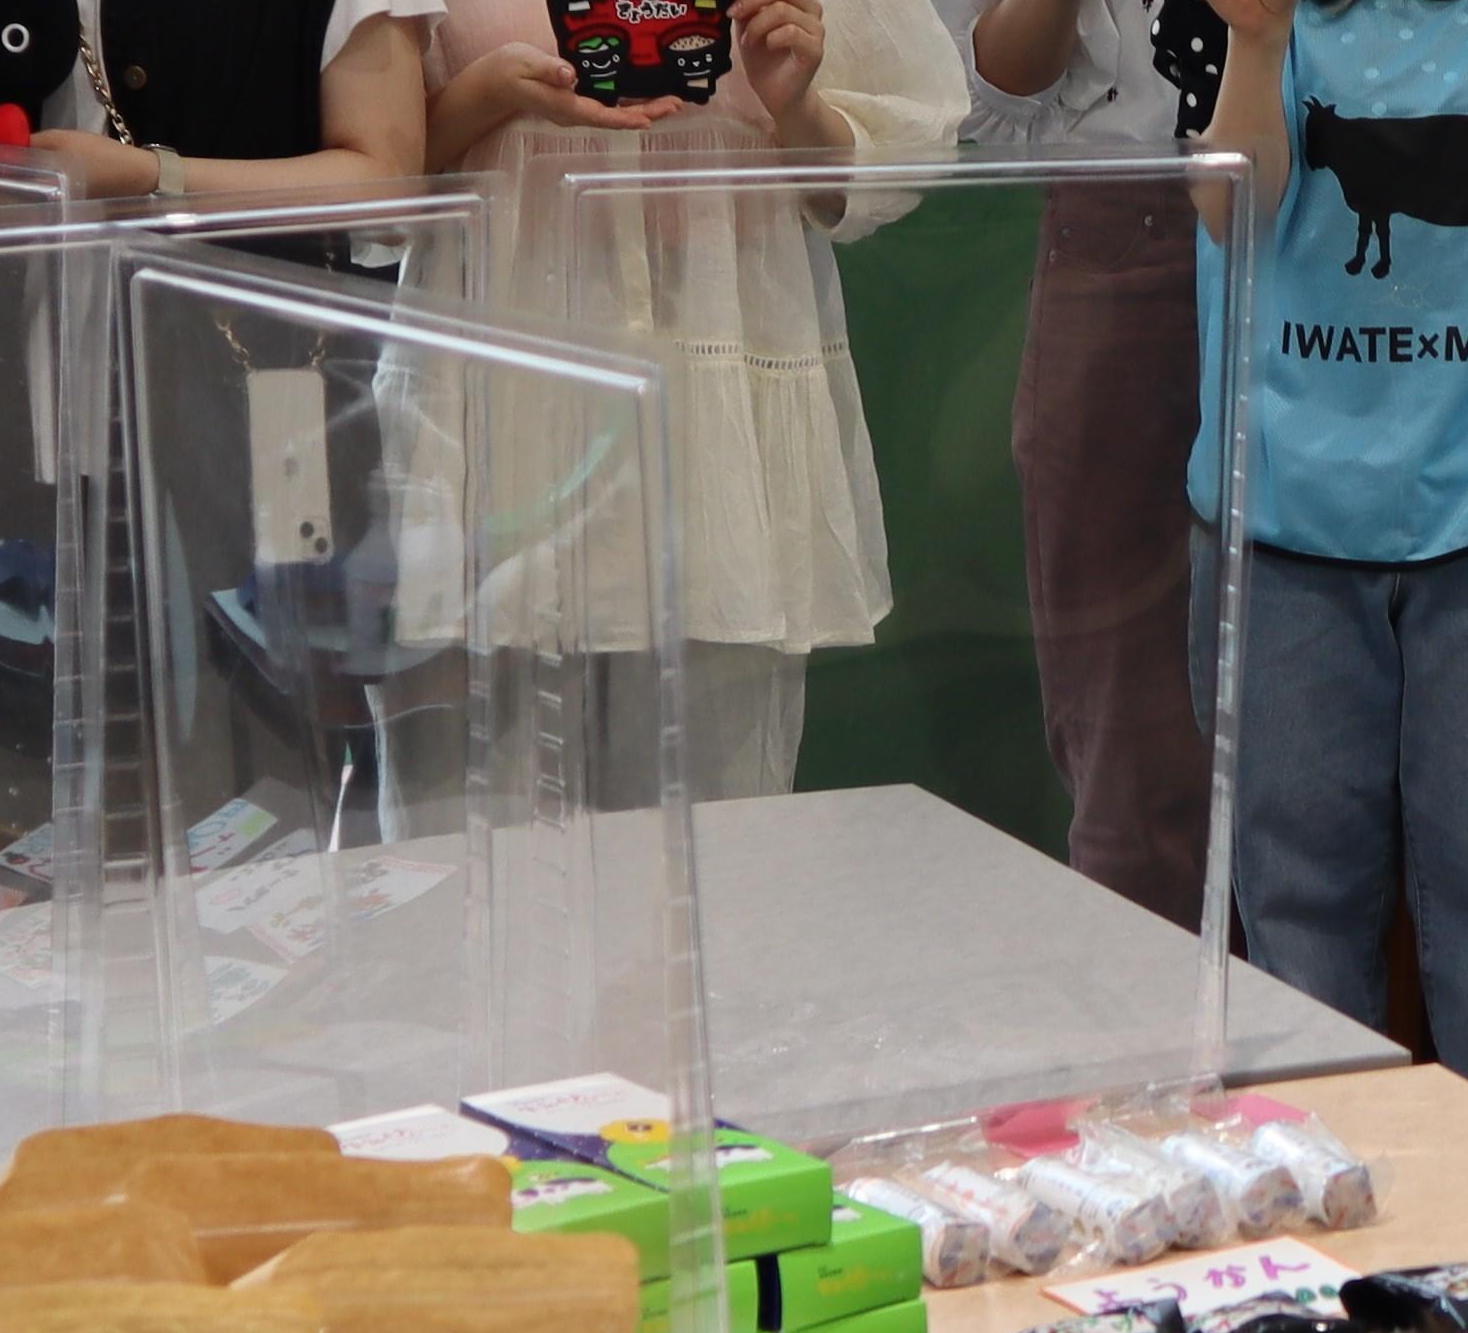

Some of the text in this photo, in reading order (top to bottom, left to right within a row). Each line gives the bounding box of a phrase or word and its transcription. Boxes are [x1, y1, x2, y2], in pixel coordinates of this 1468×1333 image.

[615, 1, 687, 24] きょうだい
